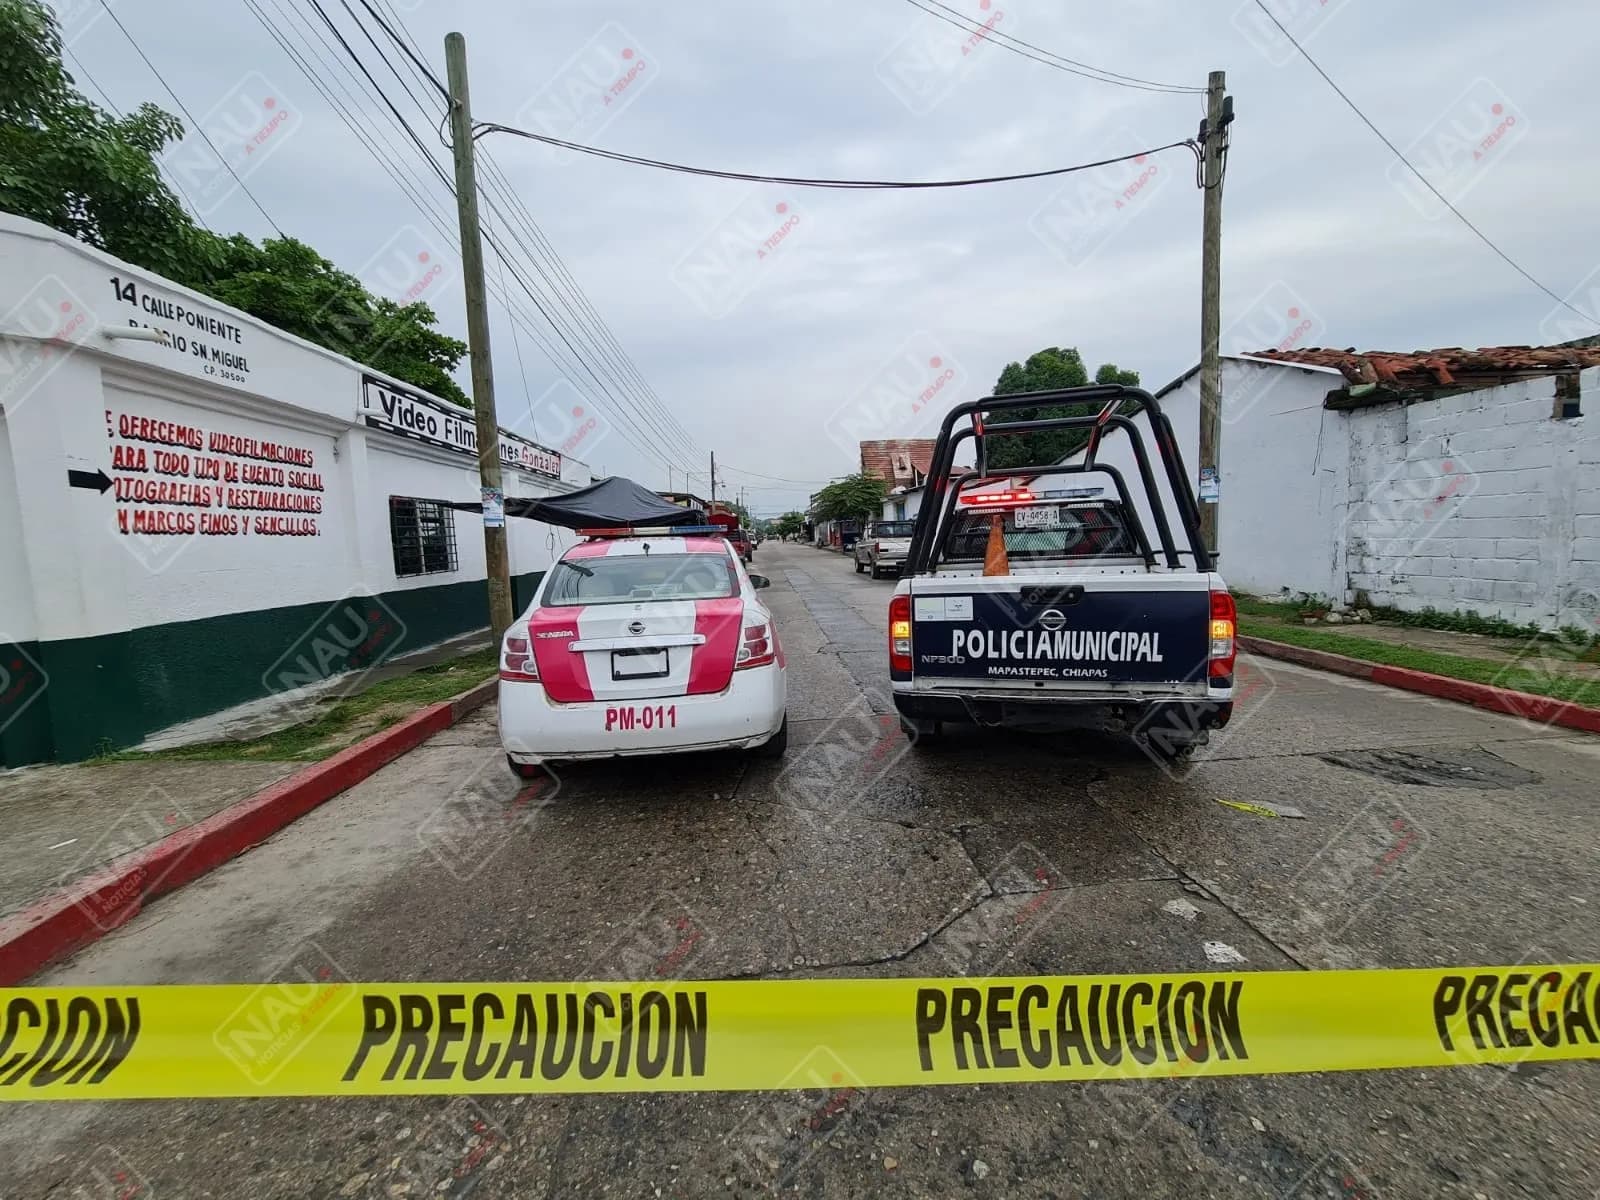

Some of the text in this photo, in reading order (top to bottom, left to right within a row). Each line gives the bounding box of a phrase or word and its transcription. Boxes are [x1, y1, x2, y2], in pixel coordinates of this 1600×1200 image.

[110, 277, 242, 345] 14 CALLE PONIENTE
[191, 341, 211, 361] SN.
[212, 348, 250, 373] MIGUEL
[203, 364, 246, 383] C.P. 30500
[119, 414, 204, 451] OFRECEMOS
[209, 432, 314, 468] VIDEOFILMACIONES
[378, 389, 437, 435] Video
[521, 446, 561, 475] Gonzalez
[110, 444, 325, 491] ARA TODO TIPO DE EVENTO SOCIAL
[216, 486, 224, 507] Y
[227, 488, 322, 514] RESTAURACIONES
[133, 510, 196, 535] MARCOS
[200, 513, 239, 535] FINOS
[242, 515, 250, 535] Y
[921, 654, 966, 664] NP300
[952, 629, 1164, 662] POLICIA MUNICIPAL
[988, 665, 1108, 678] MAPASTEPEC, CHIAPAS
[605, 705, 676, 731] PM-011
[341, 992, 708, 1082] PRECAUCION
[916, 981, 1249, 1072] PRECAUCION
[1434, 972, 1600, 1051] PRECA
